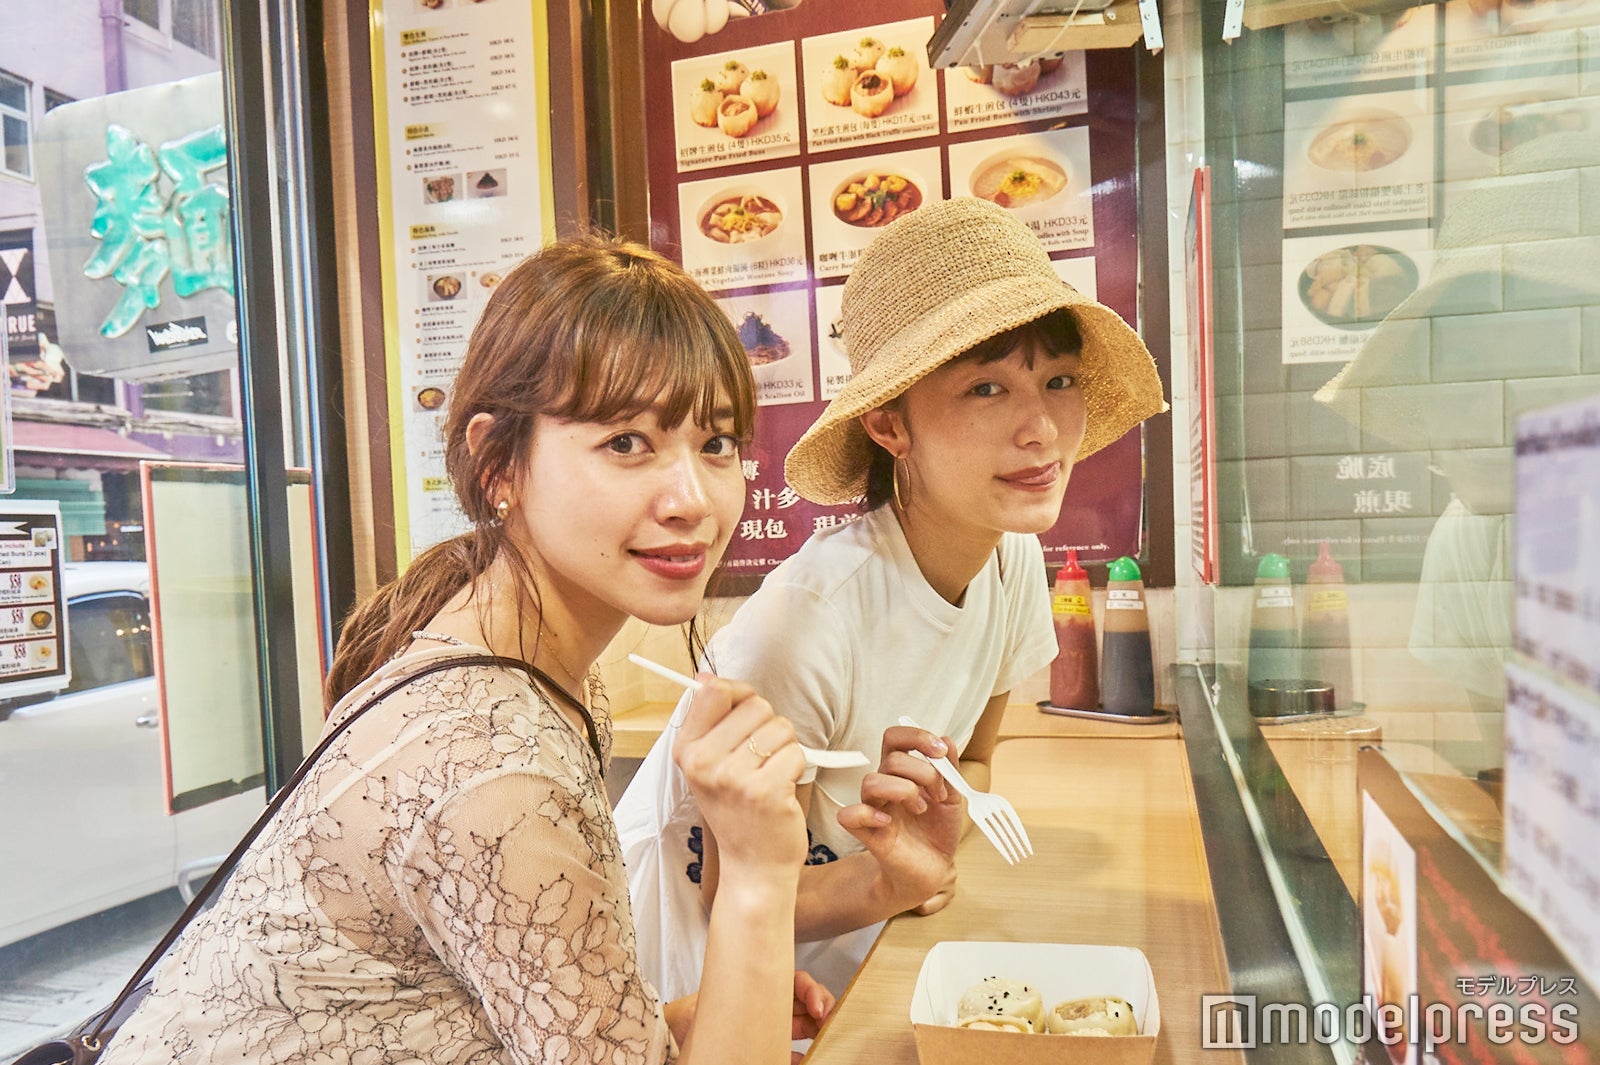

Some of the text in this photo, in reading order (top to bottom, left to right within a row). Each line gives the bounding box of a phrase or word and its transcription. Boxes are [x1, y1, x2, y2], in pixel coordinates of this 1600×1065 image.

[1035, 88, 1081, 103] HKD43元
[970, 115, 991, 124] Fried
[751, 133, 791, 145] HKD35元
[680, 156, 713, 166] Signature
[714, 153, 728, 161] Pan
[729, 151, 747, 160] Fried
[1043, 215, 1088, 228] HKD33元
[1037, 231, 1054, 239] oodles
[819, 263, 839, 272] Curry
[763, 379, 804, 390] HKD33元
[752, 486, 801, 510] 汁多
[740, 518, 788, 541] 現包
[1042, 544, 1053, 552] for
[1091, 542, 1110, 551] only.
